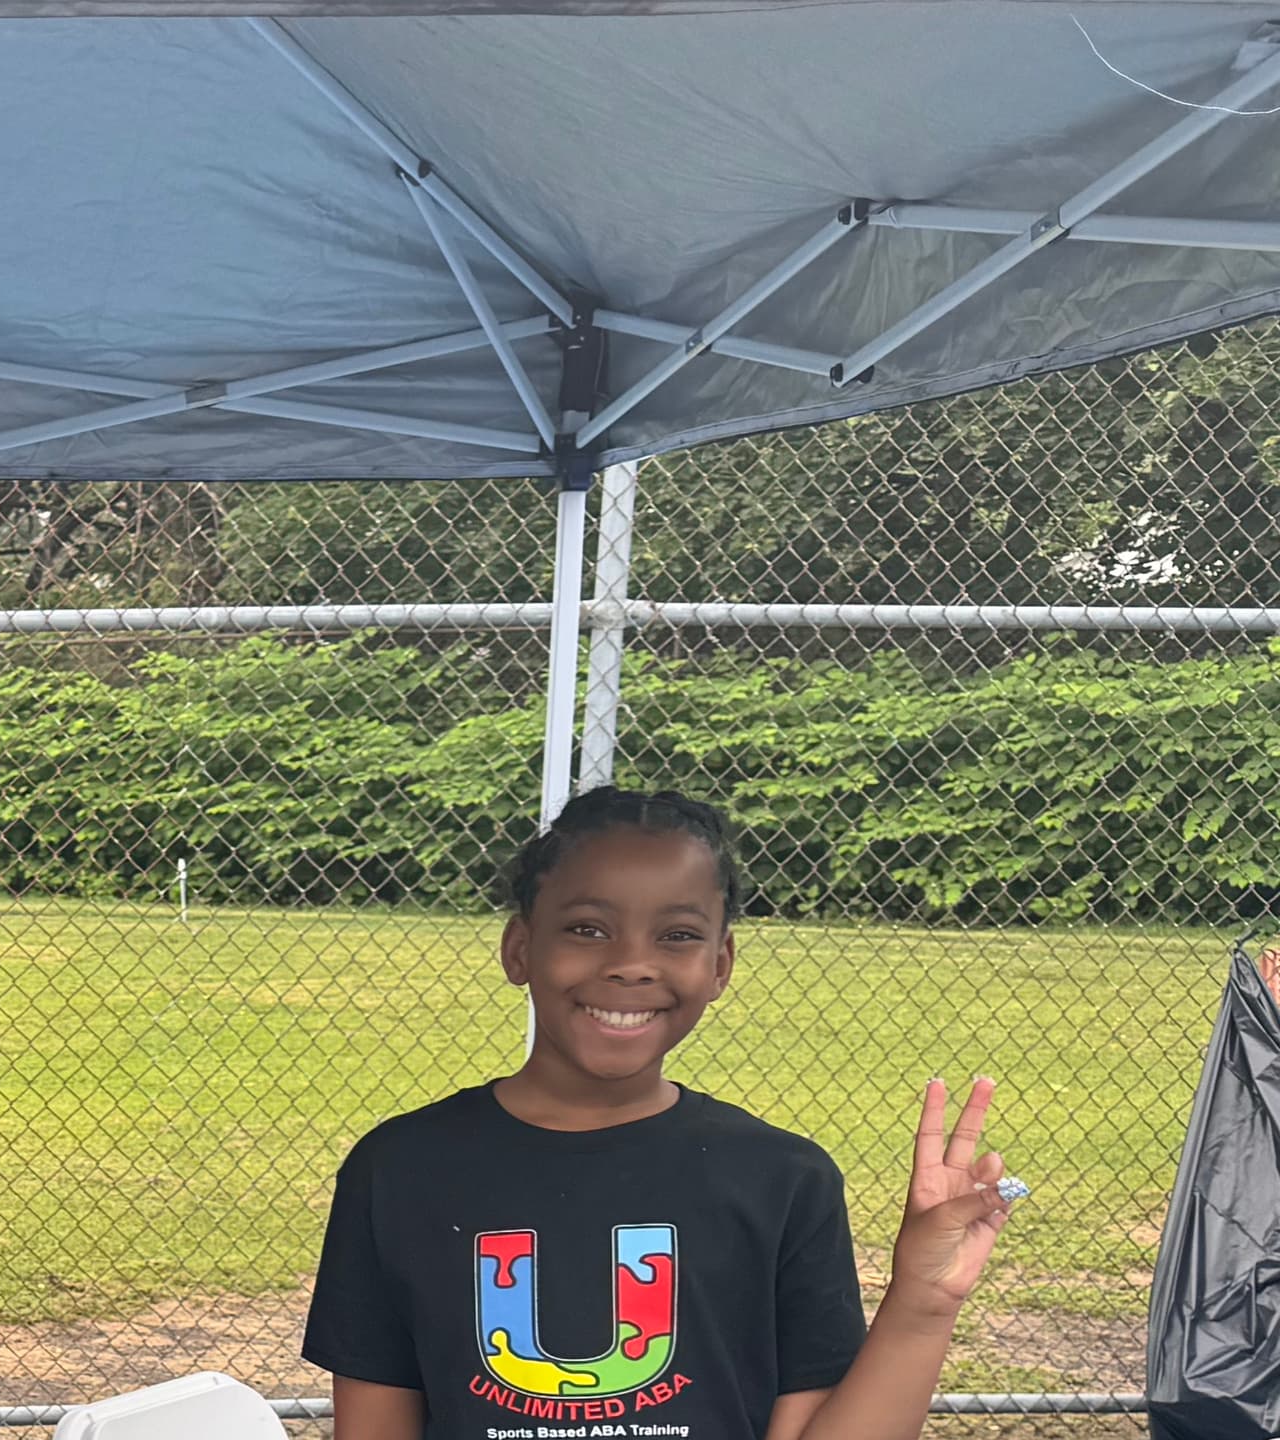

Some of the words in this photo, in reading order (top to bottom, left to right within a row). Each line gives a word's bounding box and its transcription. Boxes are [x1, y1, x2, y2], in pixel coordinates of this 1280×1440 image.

[469, 1375, 625, 1420] UNLIMITED
[634, 1373, 692, 1412] ABA
[487, 1428, 533, 1440] Sports
[537, 1427, 586, 1438] Based
[591, 1425, 626, 1437] ABA
[630, 1425, 689, 1437] Training
